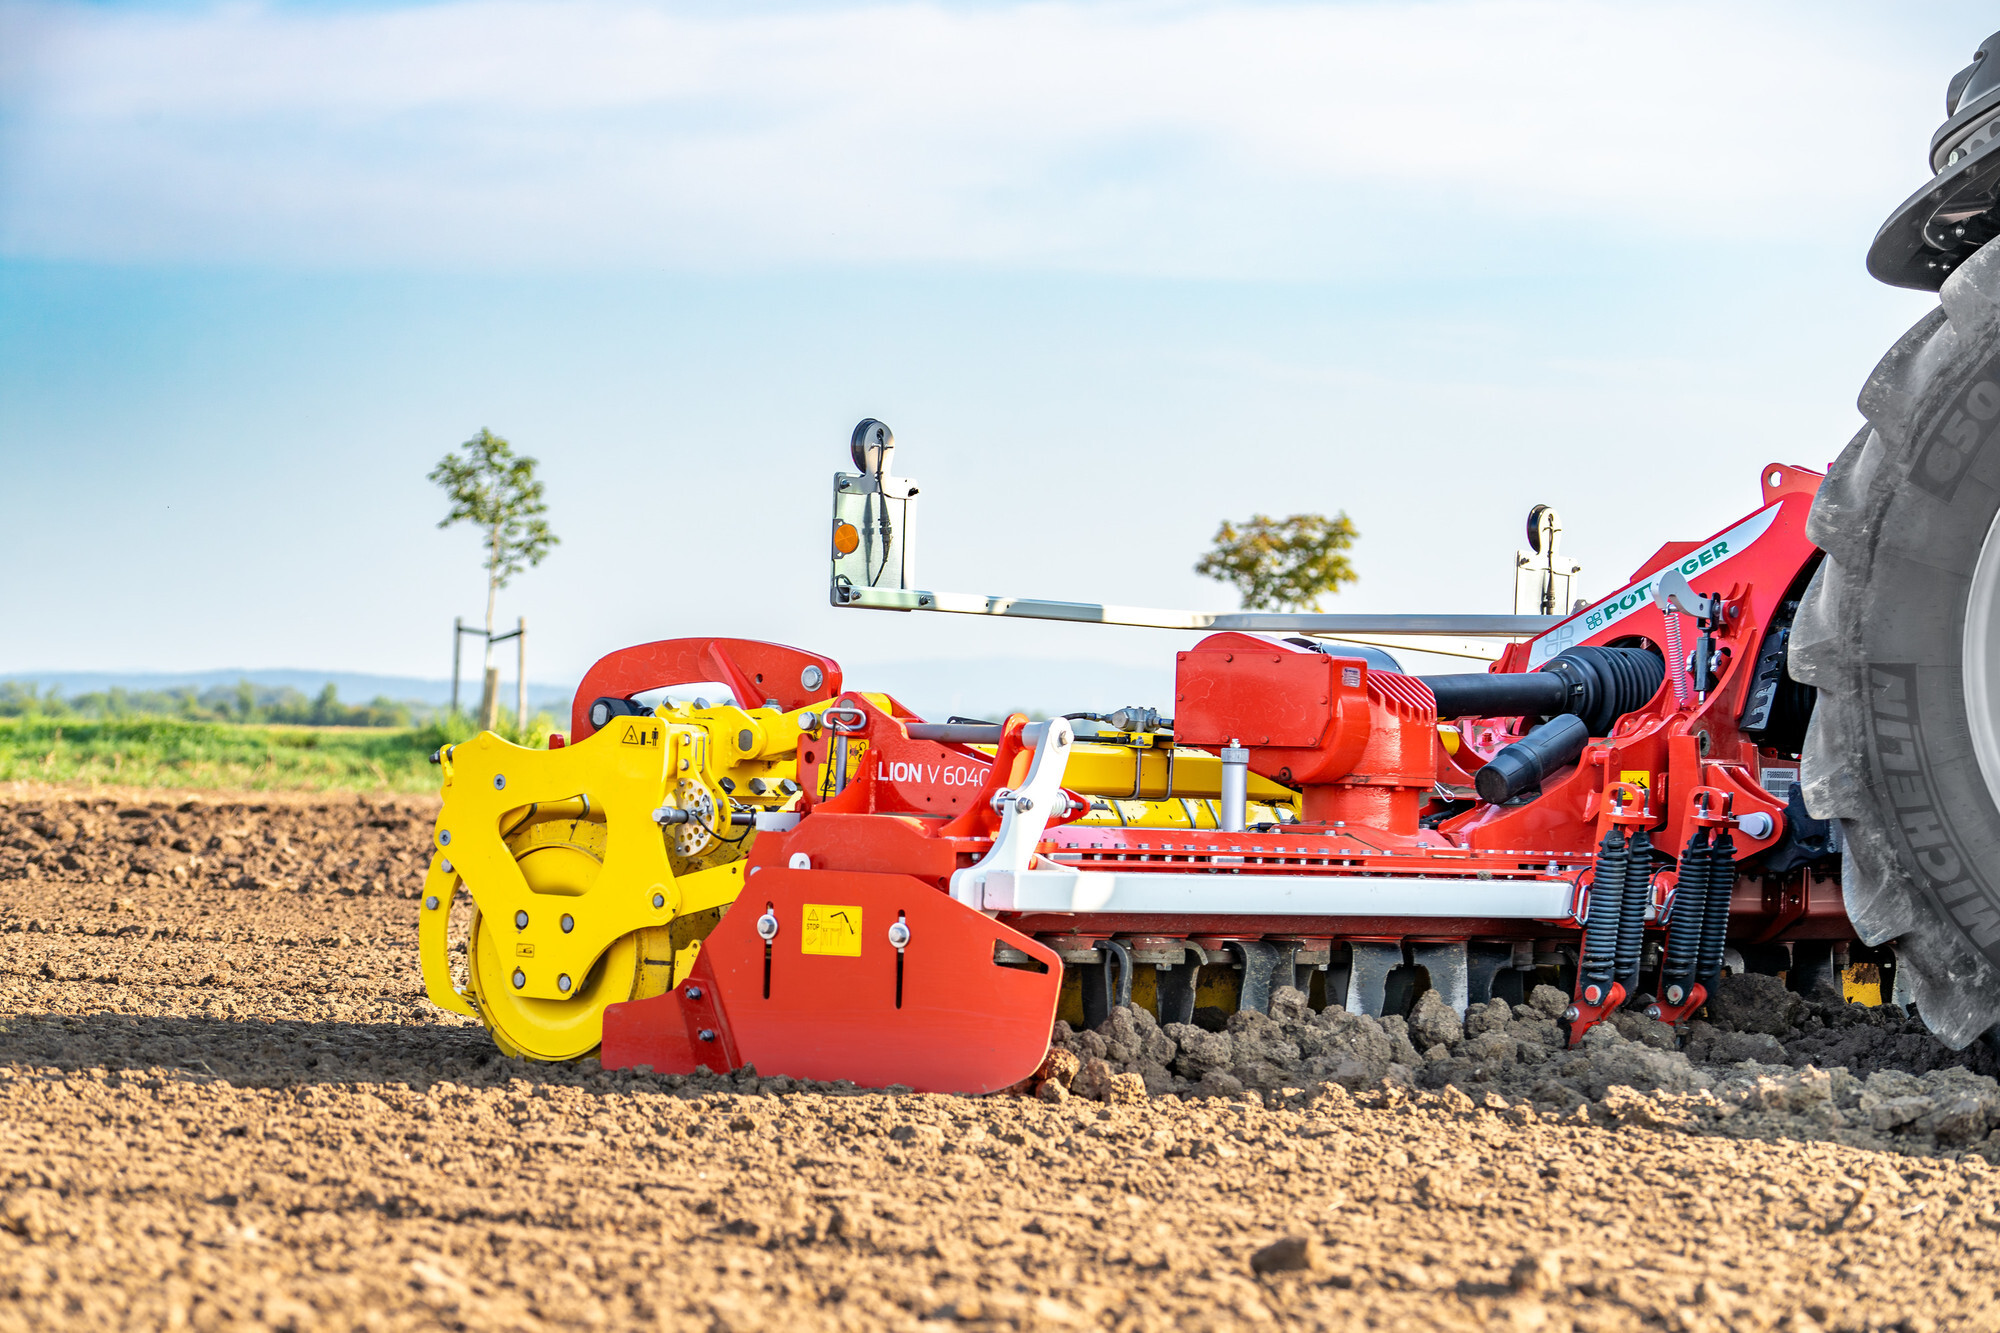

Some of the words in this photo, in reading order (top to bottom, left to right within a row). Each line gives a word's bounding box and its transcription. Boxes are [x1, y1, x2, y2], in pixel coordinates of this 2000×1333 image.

[1925, 381, 2000, 481] 650
[1603, 541, 1730, 621] PÖTGER
[877, 761, 922, 783] LION
[927, 764, 940, 784] V
[1871, 668, 2000, 949] MICHELIN
[806, 923, 820, 931] STOP
